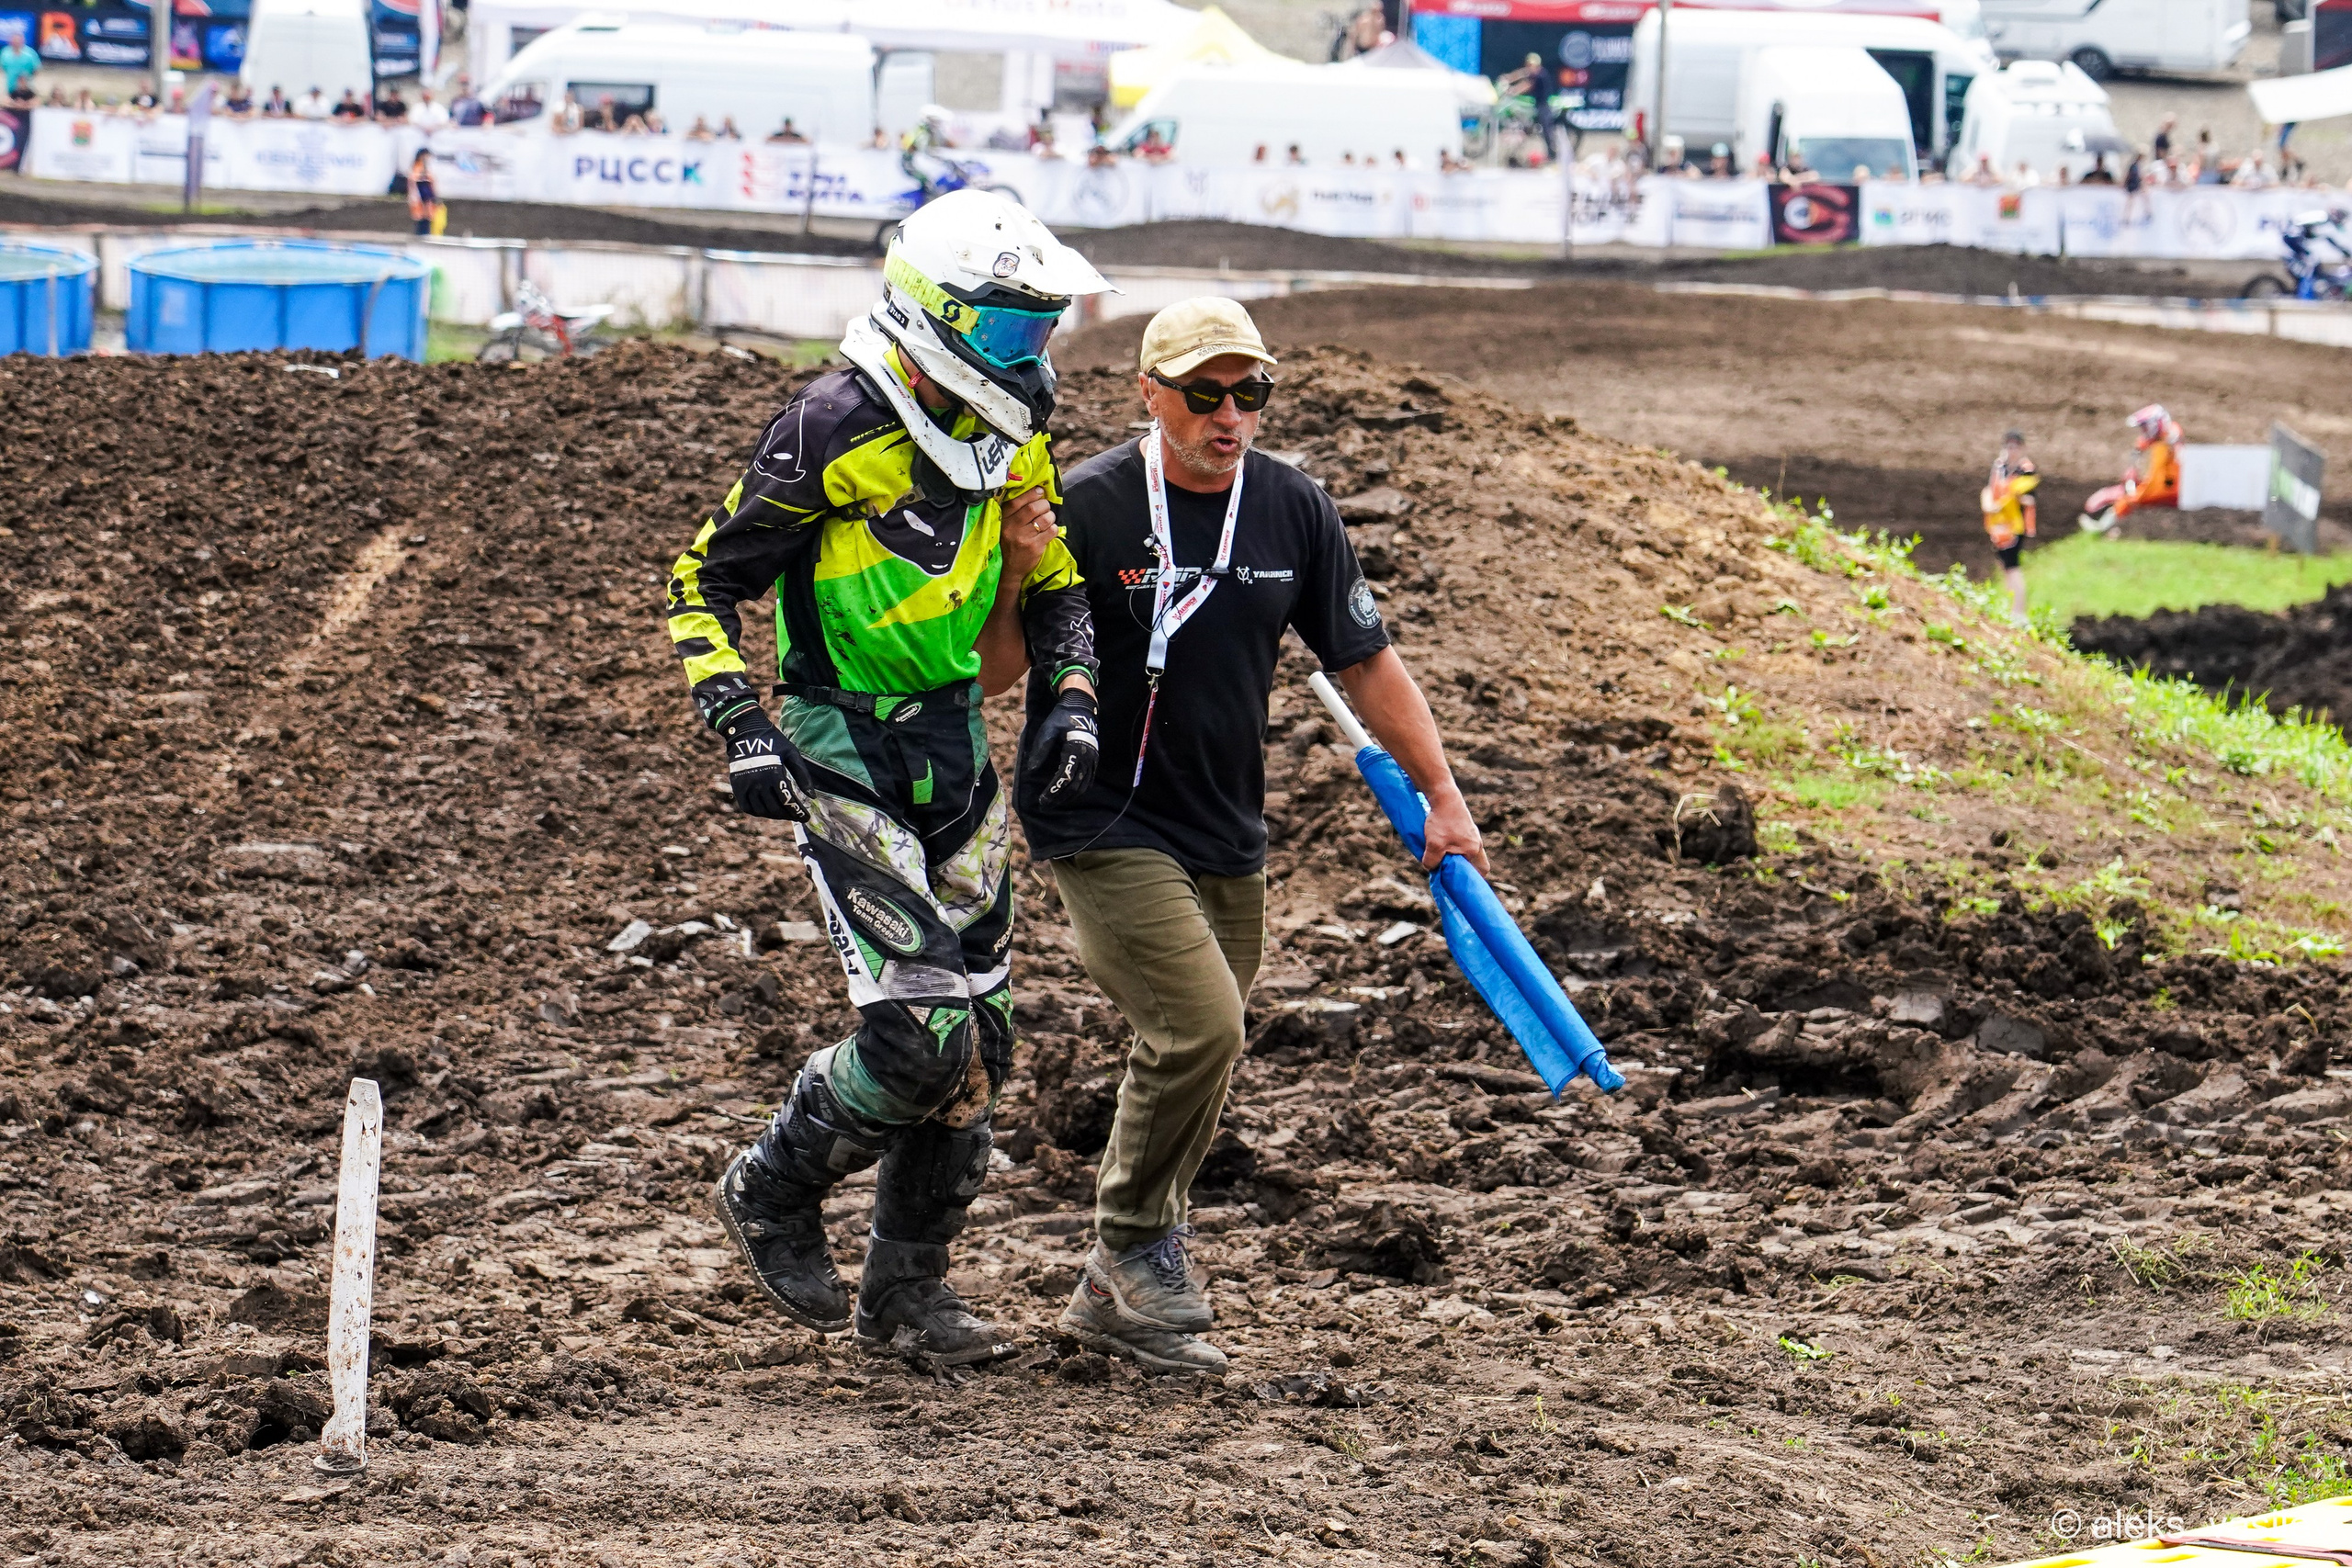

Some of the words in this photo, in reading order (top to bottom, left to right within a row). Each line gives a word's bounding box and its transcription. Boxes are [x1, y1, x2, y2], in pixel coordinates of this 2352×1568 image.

[575, 155, 704, 186] РЦССК
[845, 886, 910, 938] Kawasaki
[853, 906, 873, 925] Team
[874, 919, 894, 940] Green
